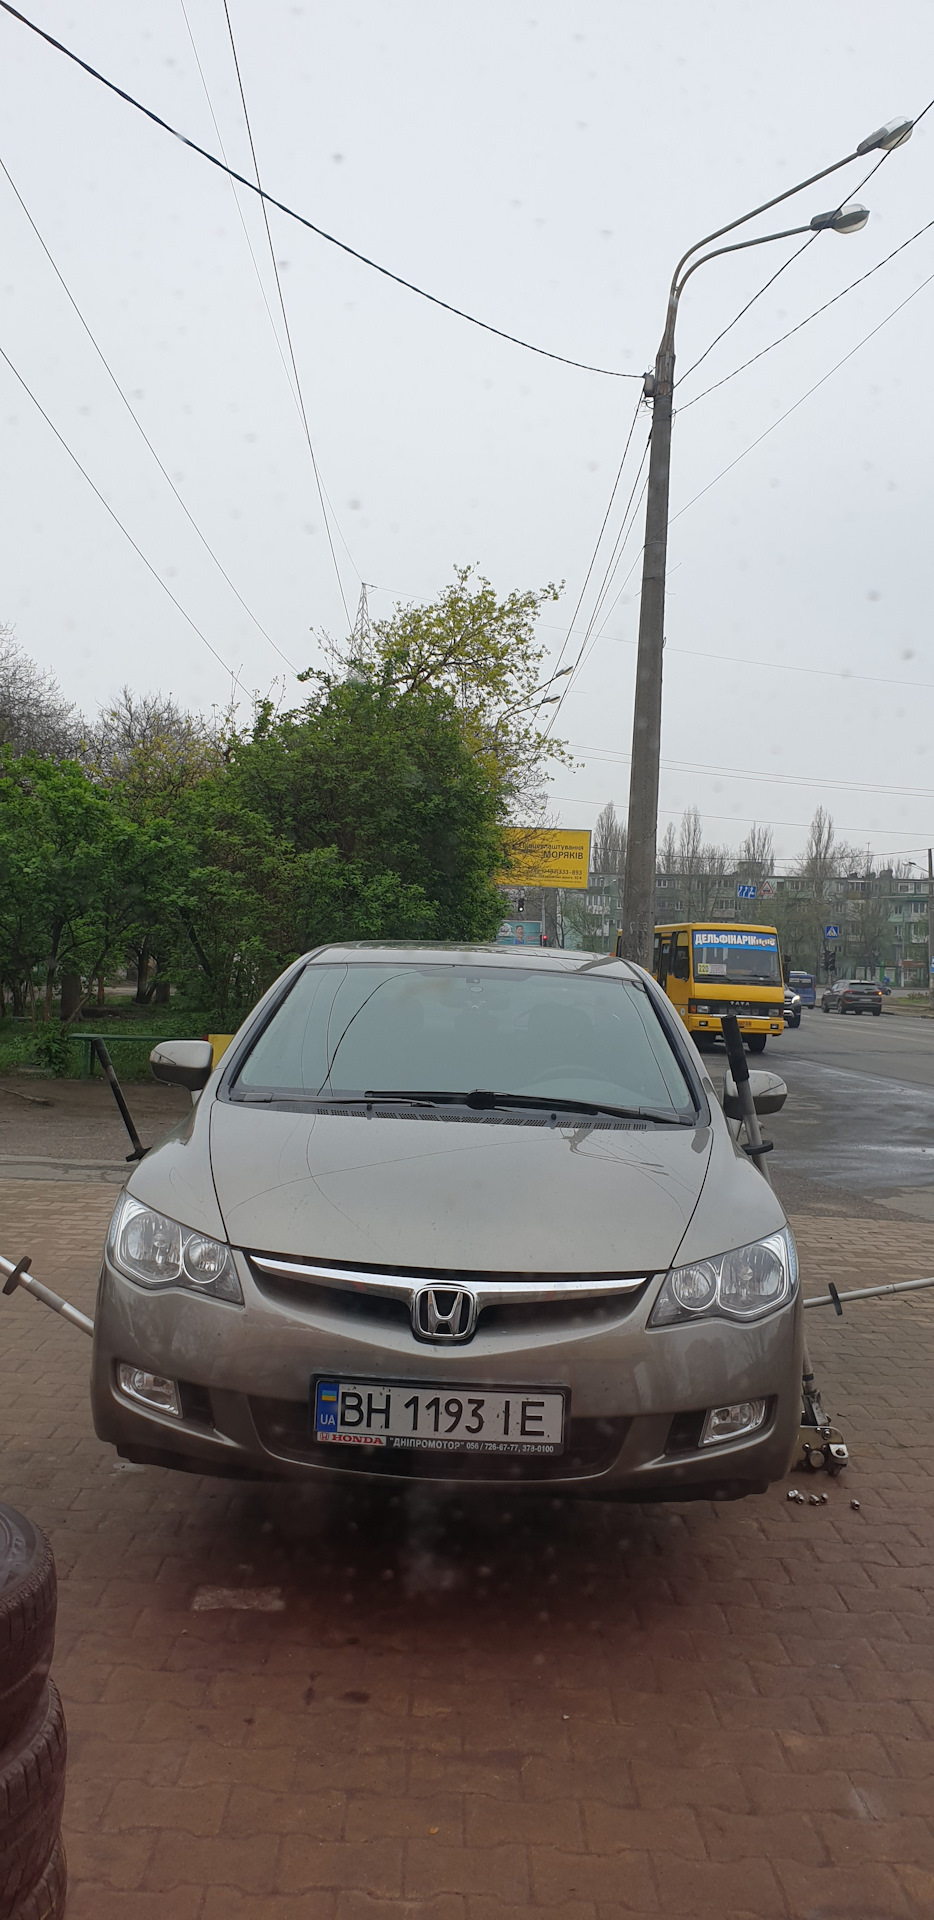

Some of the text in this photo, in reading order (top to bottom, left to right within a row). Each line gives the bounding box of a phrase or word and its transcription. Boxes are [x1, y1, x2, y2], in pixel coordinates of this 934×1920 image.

[543, 850, 583, 859] МОРЯКІВ
[340, 1391, 545, 1436] BH 1193 IE
[320, 1414, 336, 1426] UA
[332, 1434, 384, 1445] HONDA
[466, 1442, 479, 1450] 056
